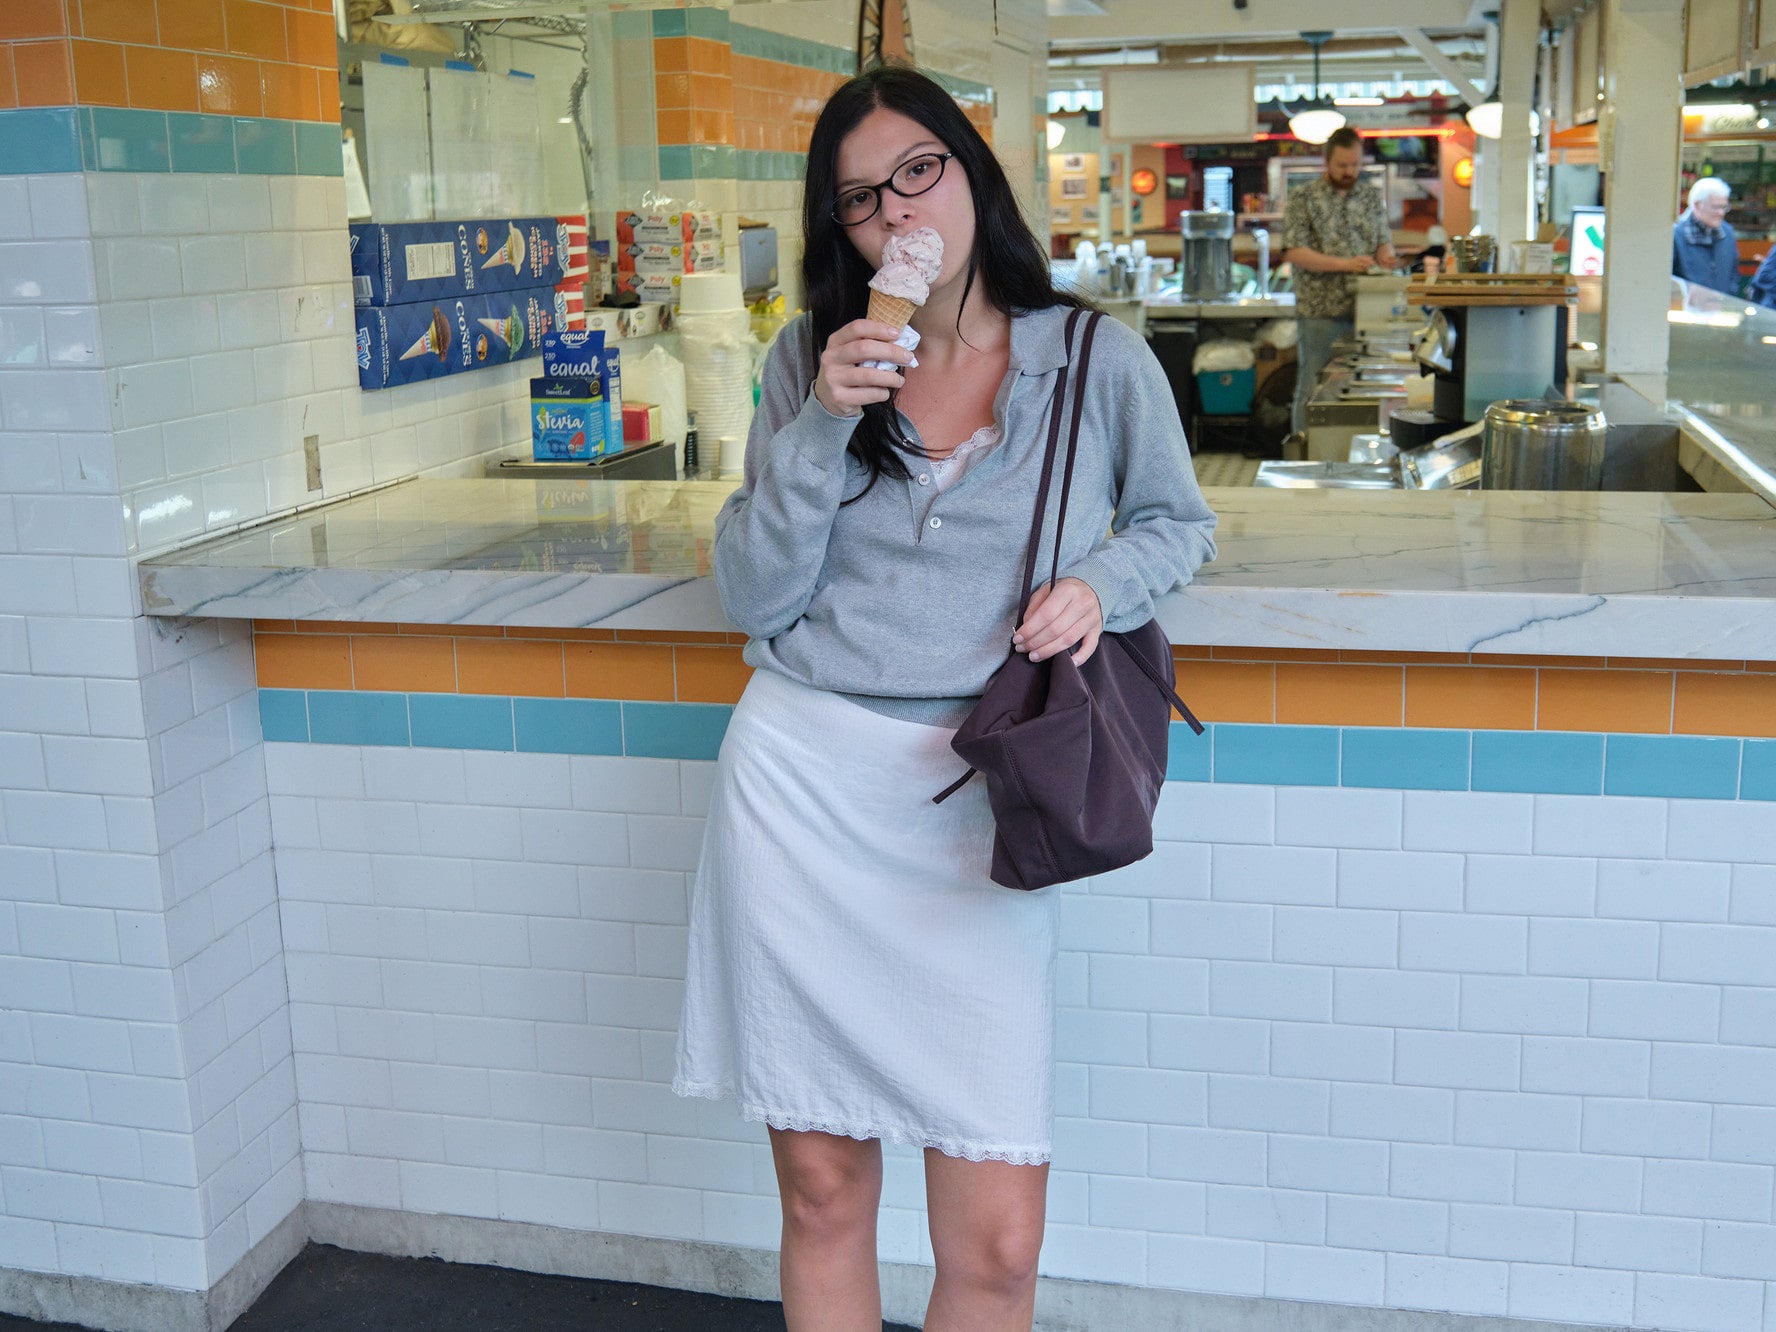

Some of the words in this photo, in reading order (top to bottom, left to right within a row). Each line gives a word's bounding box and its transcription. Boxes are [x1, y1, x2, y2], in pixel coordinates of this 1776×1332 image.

[457, 224, 473, 291] CONES
[455, 300, 470, 367] CONES
[560, 330, 590, 344] equal
[550, 355, 601, 377] equal
[606, 354, 619, 369] equal
